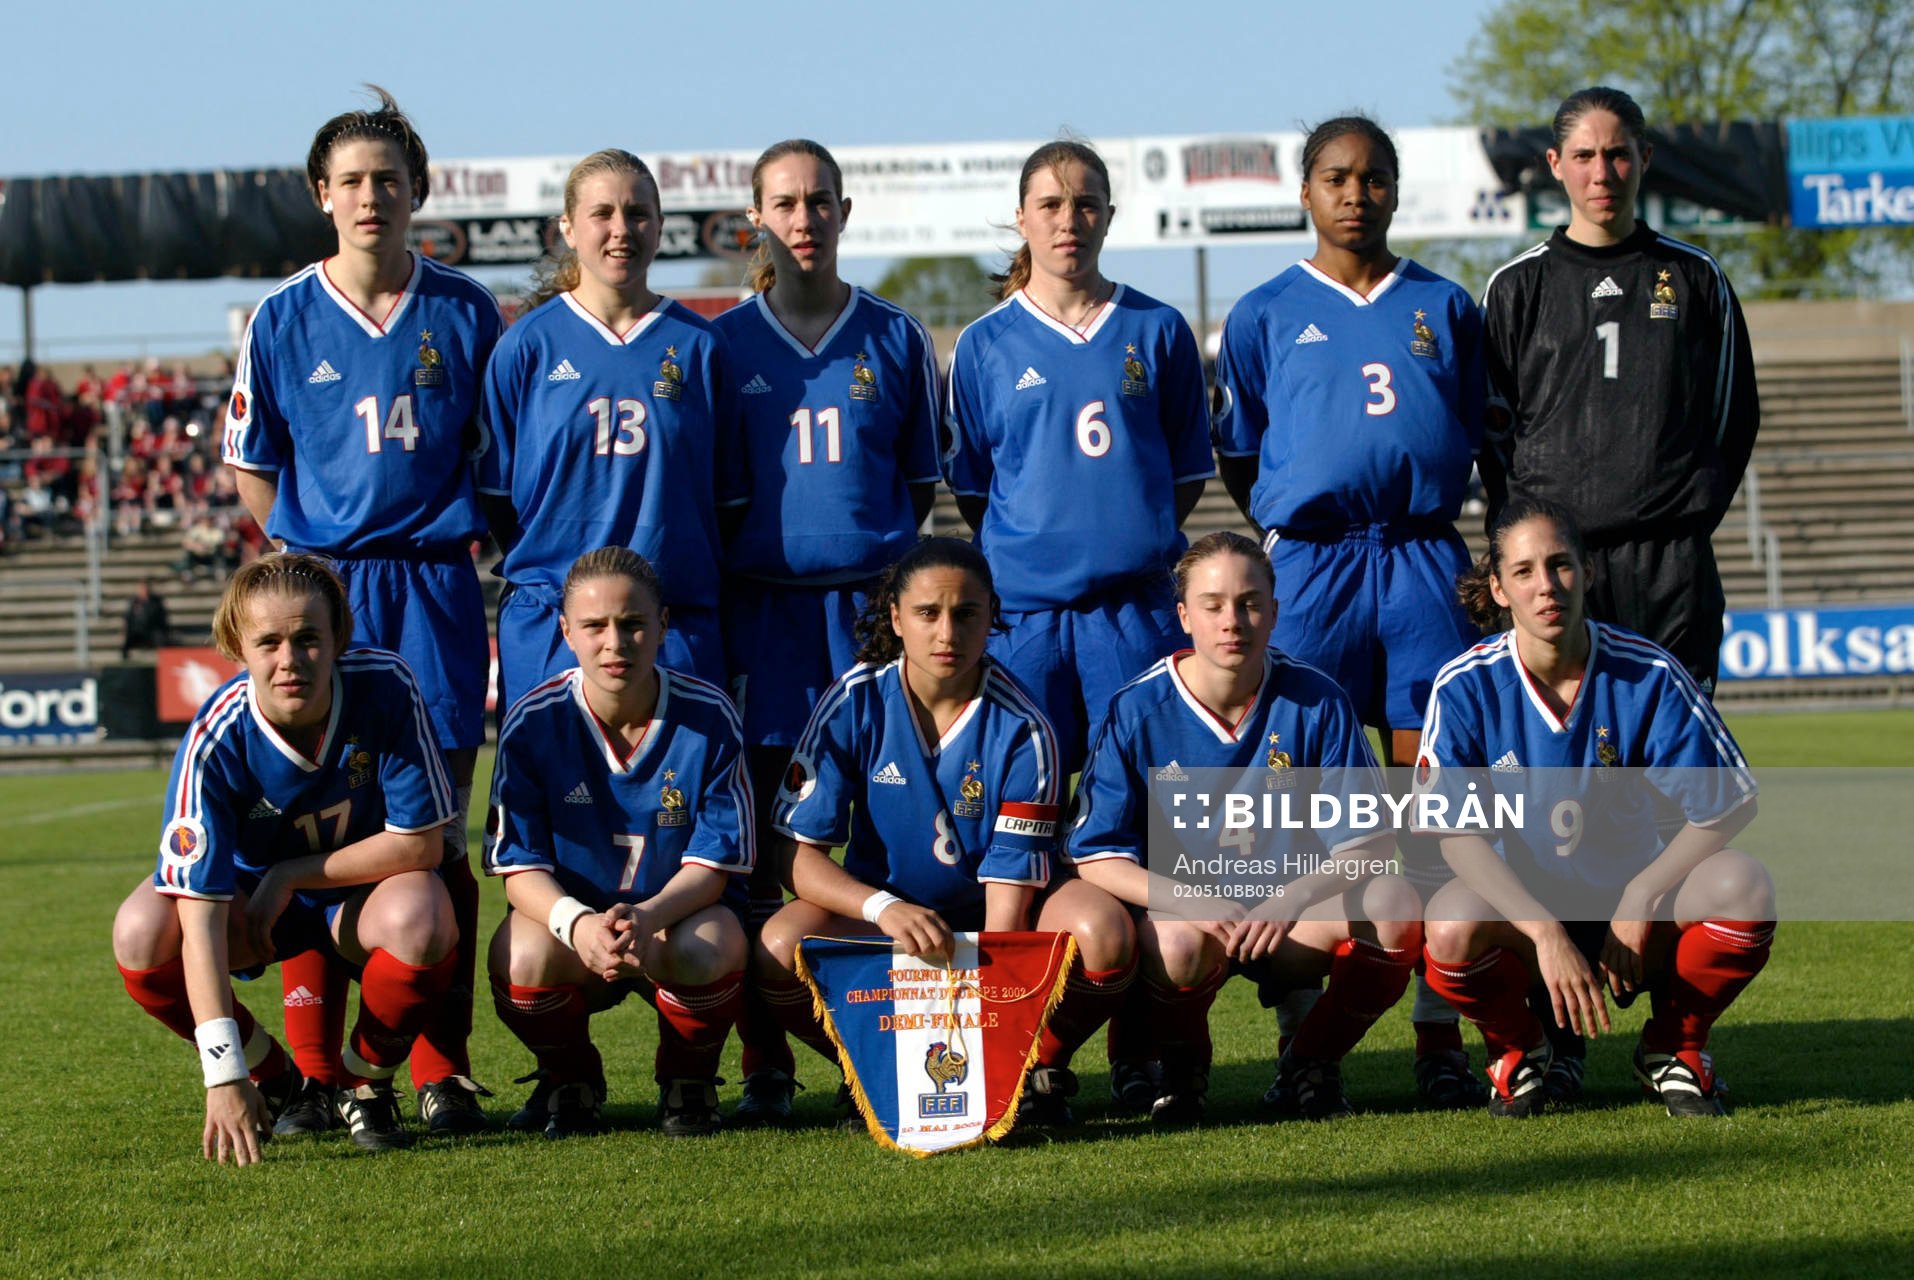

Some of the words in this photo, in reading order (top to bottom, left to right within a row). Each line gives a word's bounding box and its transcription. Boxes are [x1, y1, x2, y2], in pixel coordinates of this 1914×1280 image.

[1591, 288, 1623, 299] adidas
[1295, 333, 1328, 345] adidas
[1595, 321, 1620, 379] 1
[309, 372, 342, 384] adidas
[548, 371, 581, 381] adidas
[741, 384, 772, 394] adidas
[1015, 377, 1047, 391] adidas
[1361, 361, 1397, 417] 3
[354, 393, 419, 454] 14
[588, 396, 647, 457] 13
[789, 406, 841, 464] 11
[1076, 400, 1112, 459] 6
[1722, 612, 1914, 677] olksa
[0, 678, 98, 729] ord
[873, 774, 906, 785] adidas
[1156, 771, 1189, 782] adidas
[1491, 764, 1524, 774] adidas
[294, 798, 352, 854] 17
[933, 809, 962, 866] 8
[1550, 799, 1583, 857] 9
[613, 833, 646, 892] 7
[846, 987, 936, 1004] CHAMPIONNAT
[1001, 986, 1026, 999] 2002
[878, 1012, 999, 1032] DEMI-FINALE
[919, 1123, 948, 1133] MAI
